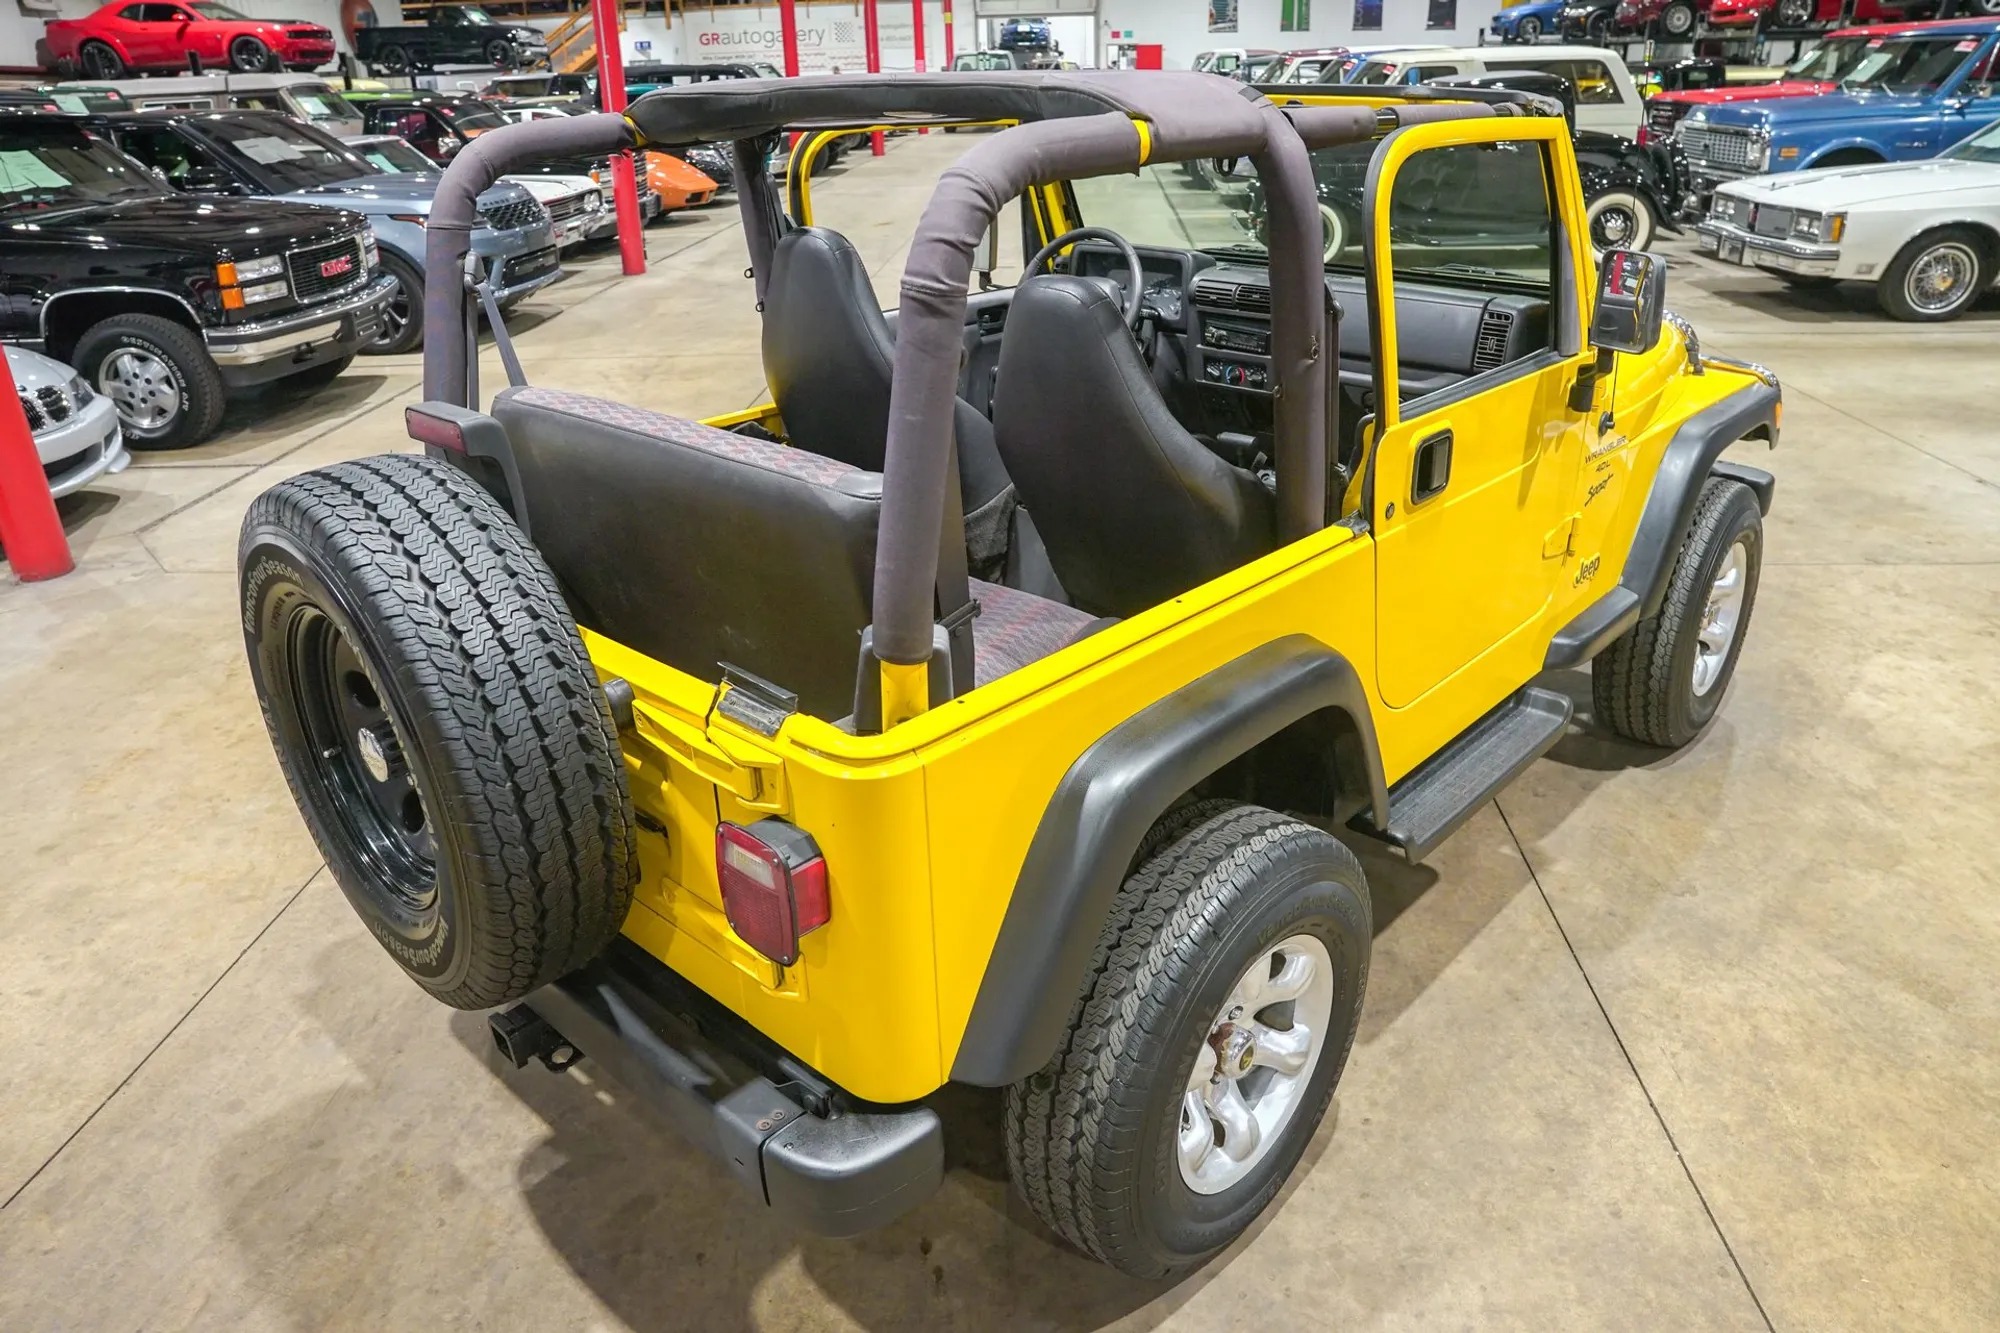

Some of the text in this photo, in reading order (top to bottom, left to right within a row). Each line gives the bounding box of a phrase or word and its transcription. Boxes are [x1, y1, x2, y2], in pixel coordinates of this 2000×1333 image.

[699, 28, 825, 48] GRautogaery
[320, 254, 352, 278] GMC
[1584, 435, 1627, 465] WRANGLER
[1584, 473, 1614, 508] Sport
[1574, 556, 1600, 585] Jeep
